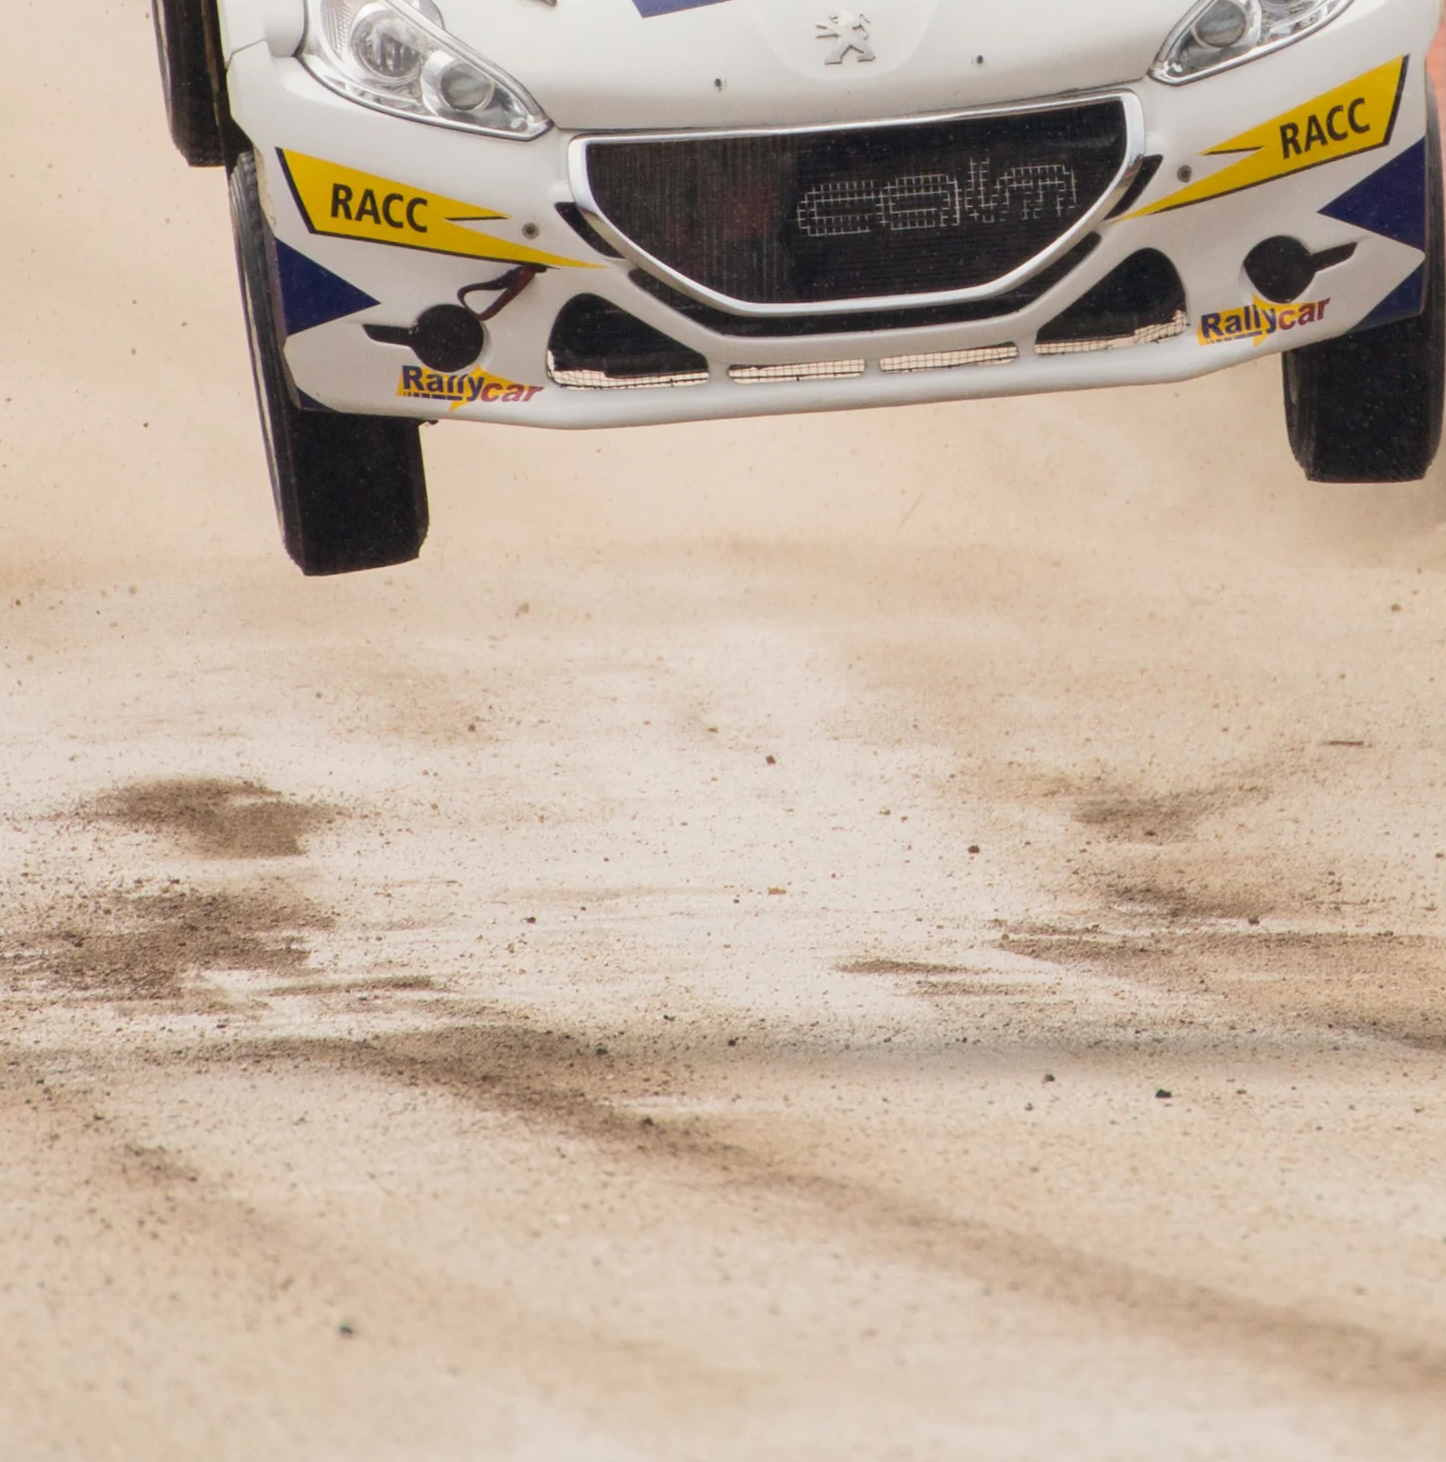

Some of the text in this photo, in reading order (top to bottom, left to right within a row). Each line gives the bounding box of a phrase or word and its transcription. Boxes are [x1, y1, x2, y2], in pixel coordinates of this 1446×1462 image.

[1279, 96, 1370, 160] RACC
[330, 182, 428, 233] RACC
[1201, 297, 1332, 339] Rallycar
[401, 365, 545, 403] Rallycar
